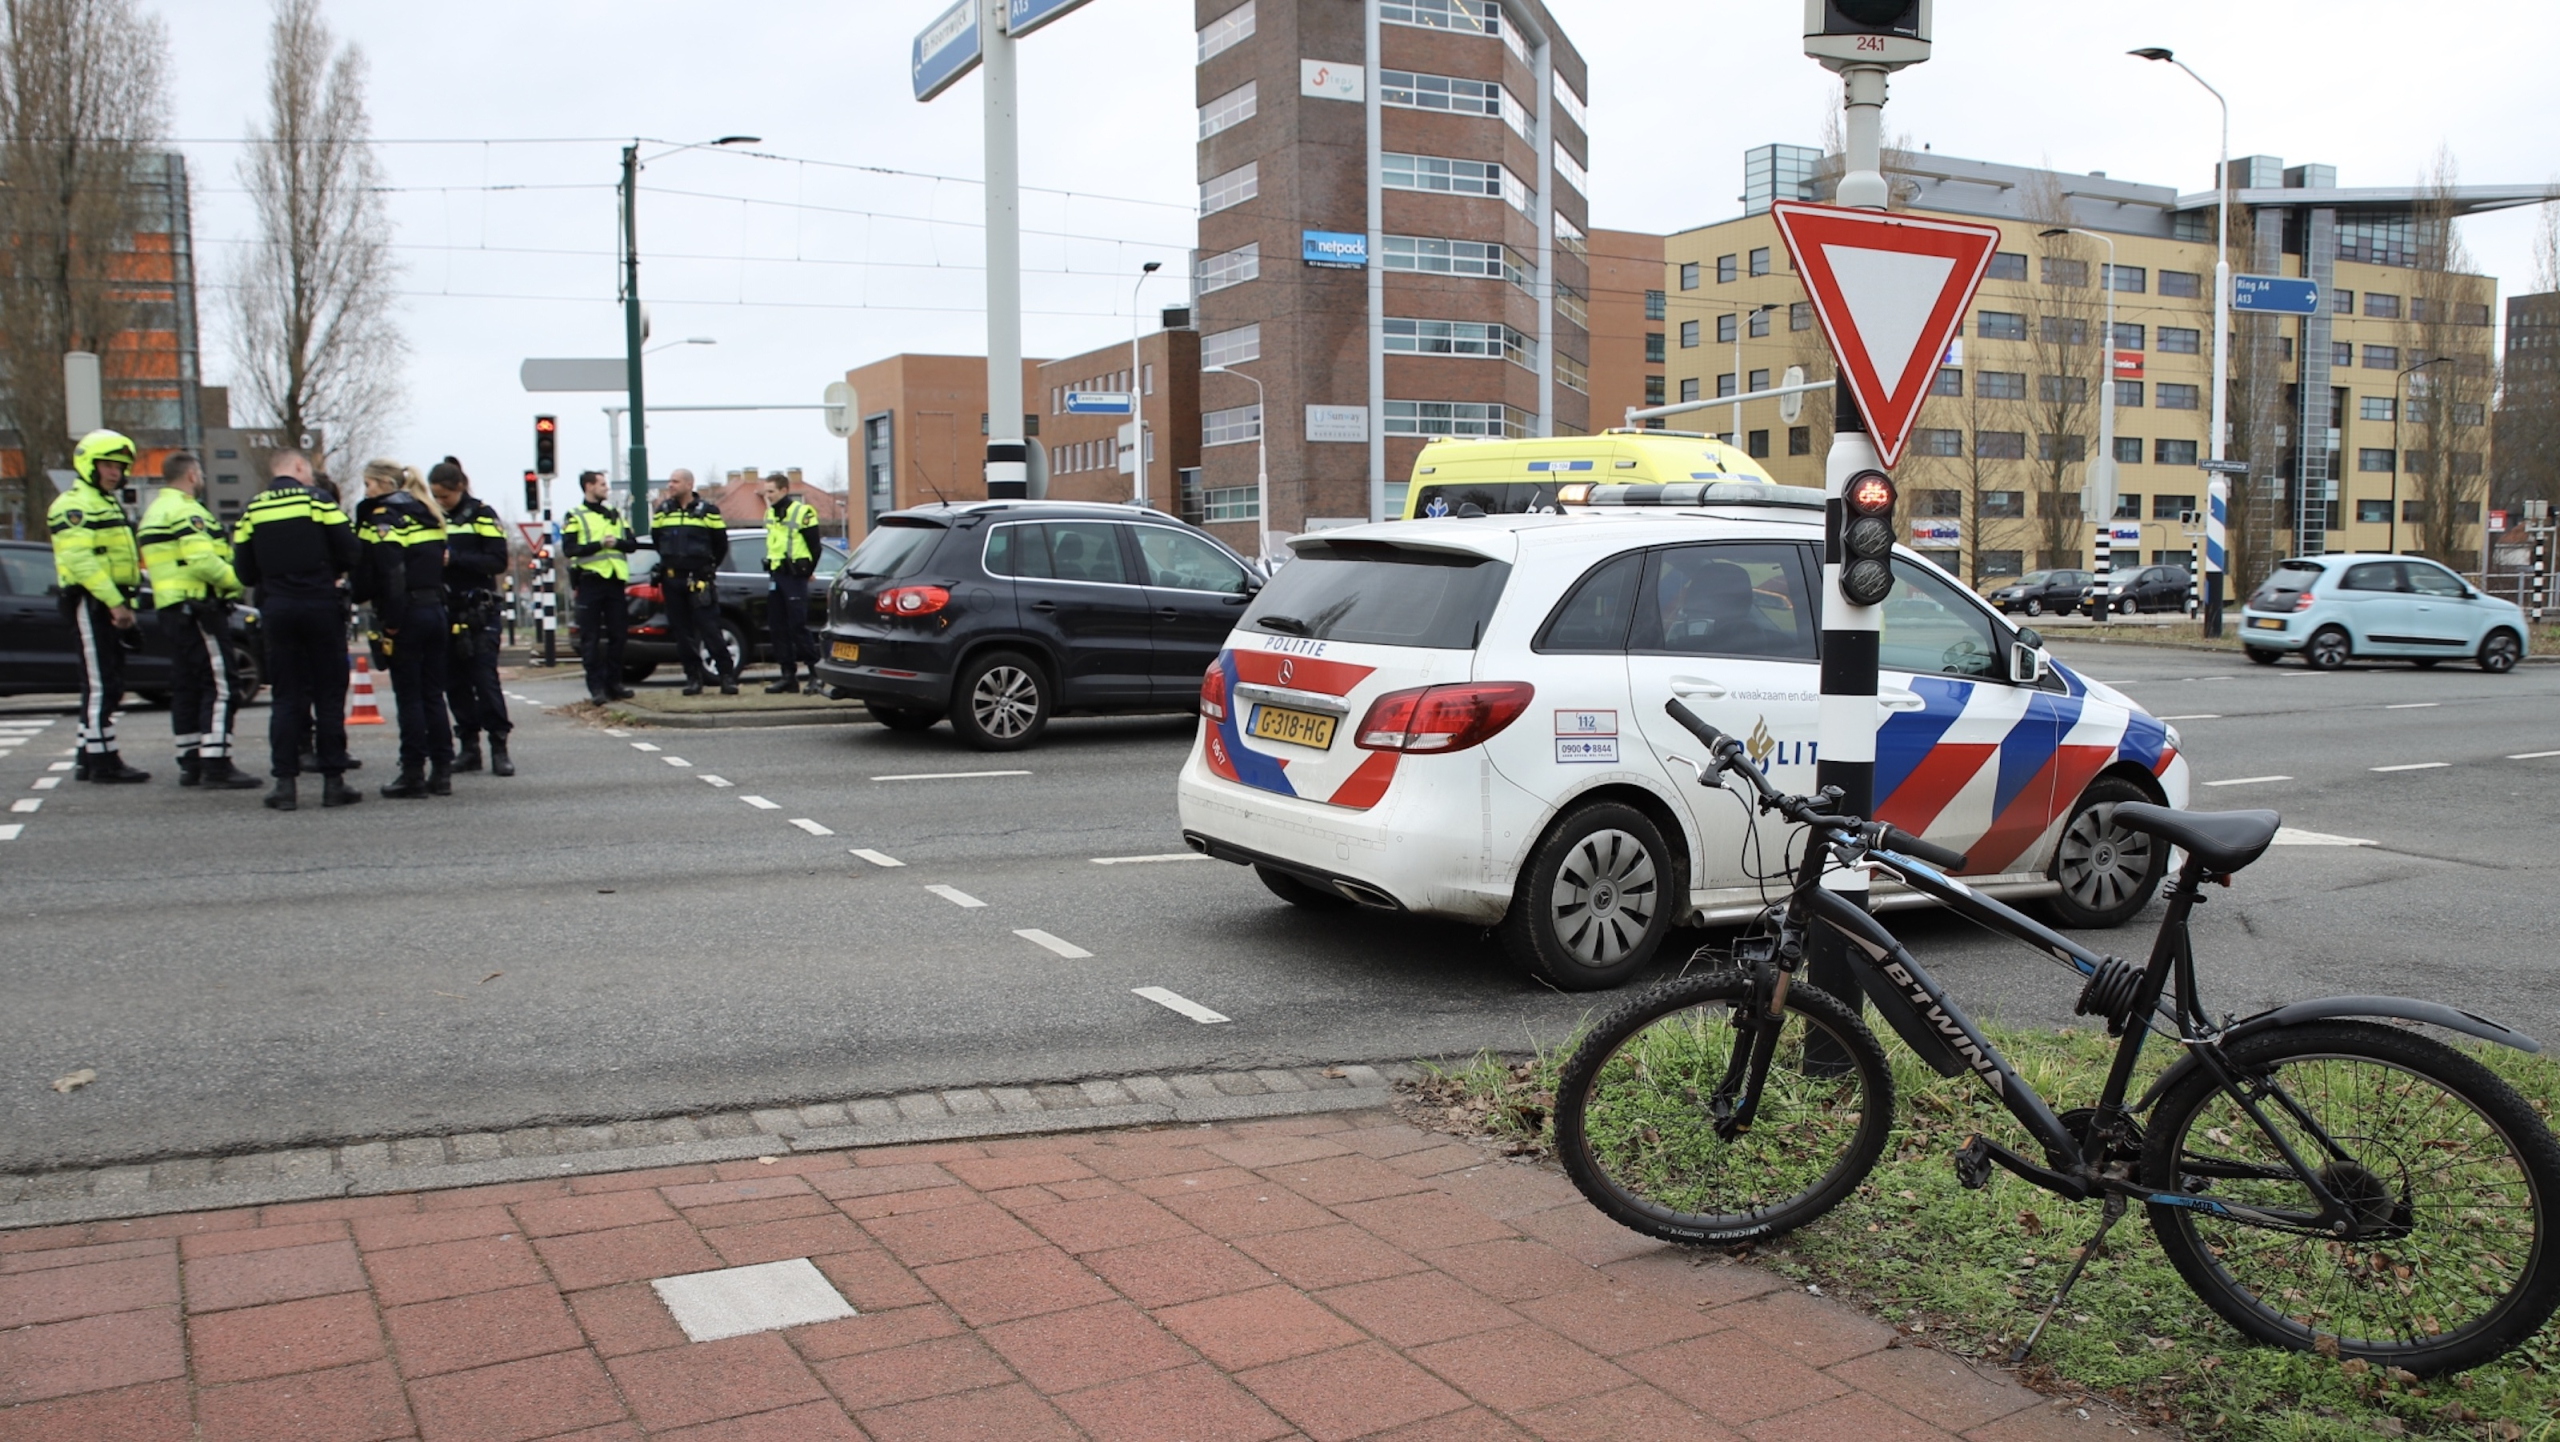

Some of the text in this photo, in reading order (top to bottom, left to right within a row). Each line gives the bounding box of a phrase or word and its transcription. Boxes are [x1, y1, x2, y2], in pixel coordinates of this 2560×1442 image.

[1012, 0, 1029, 18] A13
[1856, 36, 1885, 51] 24.1
[1318, 239, 1365, 257] netpack
[2237, 279, 2270, 292] Ring A4
[2237, 294, 2252, 304] A13
[1326, 410, 1360, 424] Sunway
[1264, 636, 1327, 657] POLITIE
[1738, 689, 1787, 701] waakzaam
[1788, 692, 1800, 701] en
[1261, 711, 1327, 744] G-318-HG
[1561, 744, 1582, 754] 0900
[1592, 744, 1612, 753] 8844
[1883, 962, 1994, 1072] B'TWIN
[1708, 1225, 1760, 1240] MICHELIN
